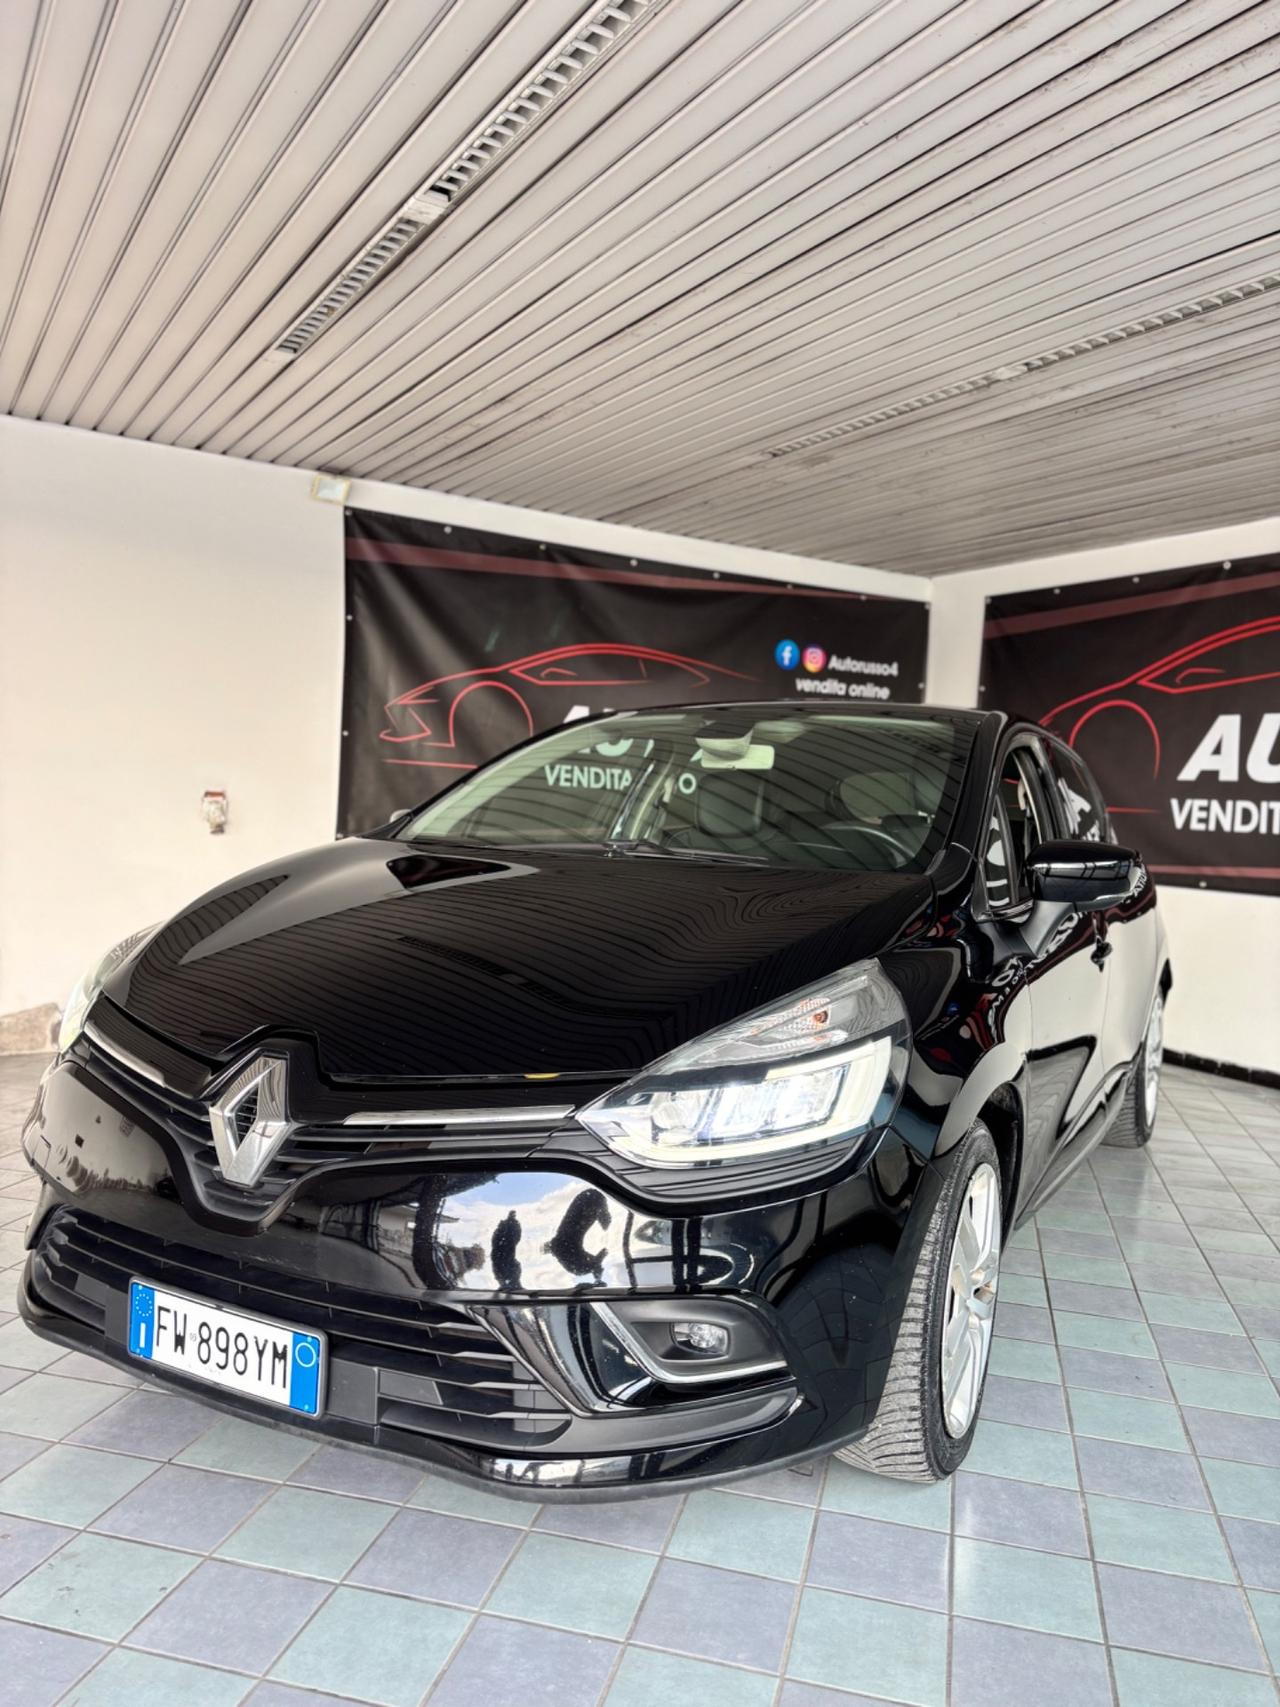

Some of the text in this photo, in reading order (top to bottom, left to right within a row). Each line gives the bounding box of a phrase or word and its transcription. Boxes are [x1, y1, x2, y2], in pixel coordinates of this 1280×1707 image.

[827, 653, 899, 677] Autorusso4
[795, 677, 890, 700] vendita online
